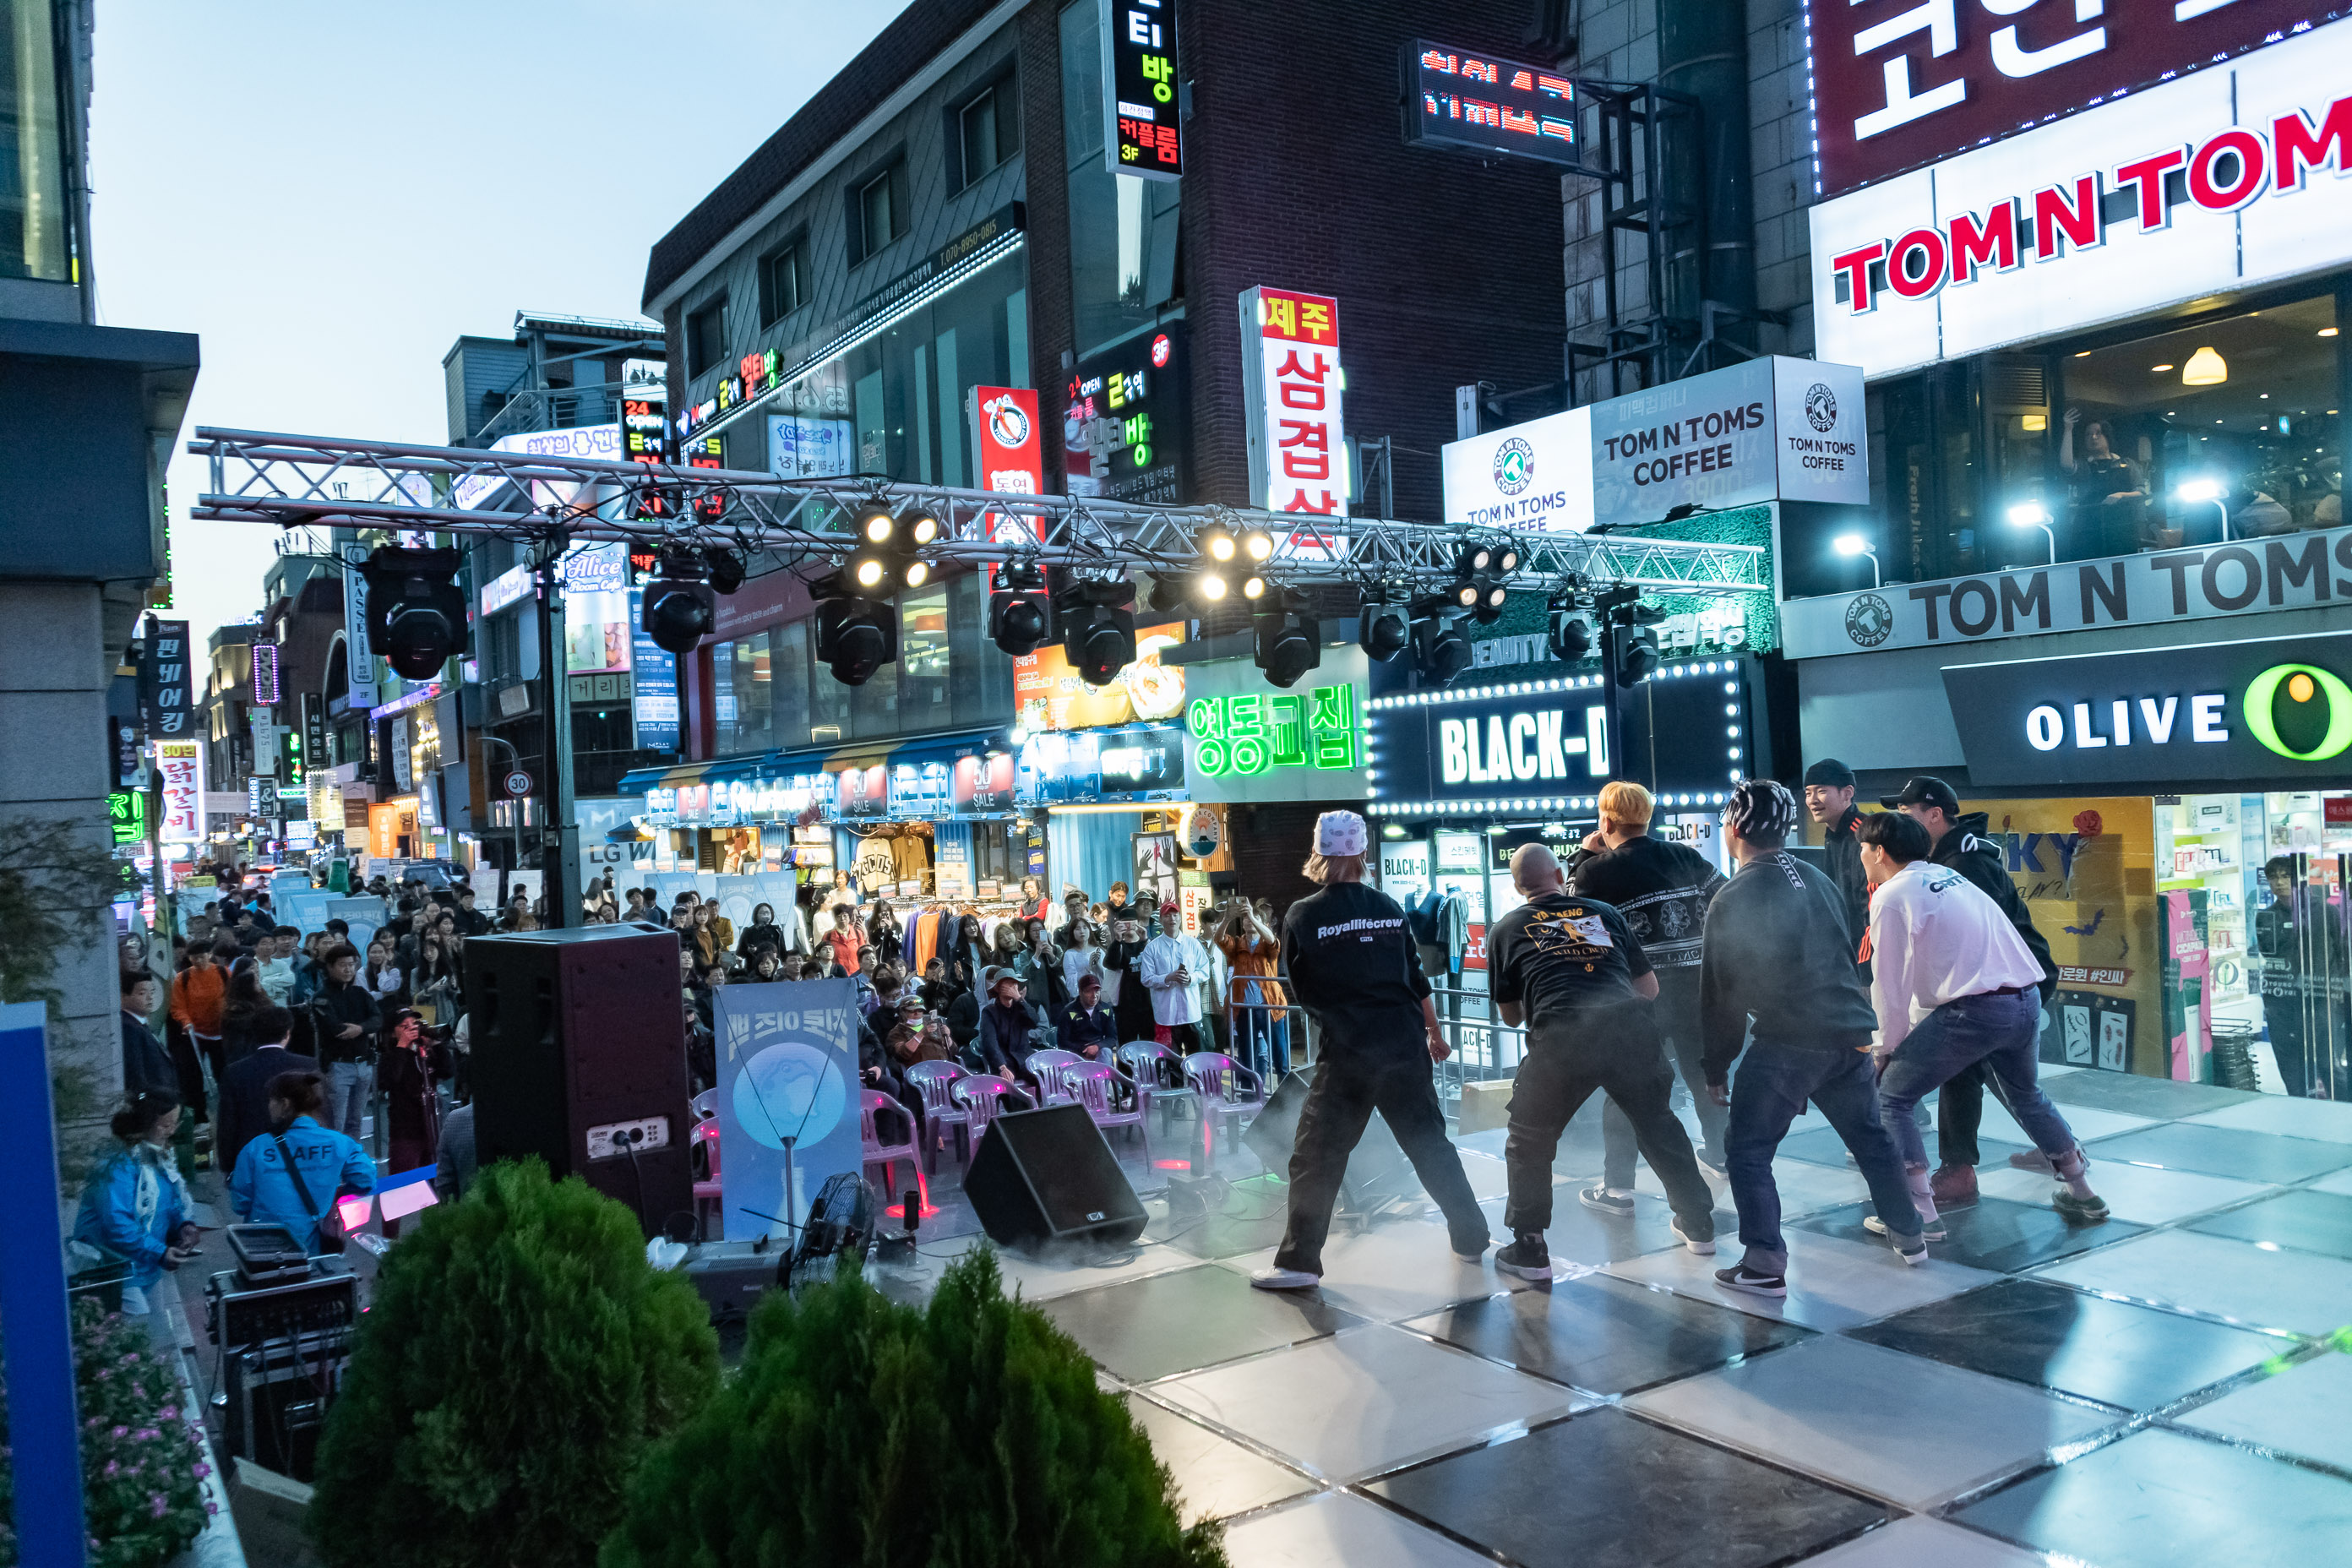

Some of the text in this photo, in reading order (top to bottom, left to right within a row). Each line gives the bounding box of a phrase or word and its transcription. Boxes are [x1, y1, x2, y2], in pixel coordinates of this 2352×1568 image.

[1120, 119, 1178, 164] 커플룸
[1121, 144, 1139, 161] 3F
[1830, 195, 2023, 315] TOM
[2031, 170, 2105, 264] N
[1267, 297, 1330, 340] 제주
[1153, 339, 1168, 362] 3F
[1069, 374, 1101, 399] 24 OPEN
[626, 400, 649, 416] 24
[1085, 396, 1094, 417] 룸
[1603, 402, 1765, 461] TOM N TOMS
[1808, 412, 1835, 432] COFFEE
[1081, 411, 1152, 479] 멀티방
[1494, 446, 1506, 473] TOM
[1513, 438, 1534, 466] TOMS
[1788, 437, 1856, 455] TOM N TOMS
[1634, 443, 1733, 486] COFFEE
[1802, 455, 1844, 471] COFFEE
[1496, 471, 1533, 495] COFFEE
[1467, 491, 1566, 525] TOM N TOMS
[567, 553, 623, 579] Alice
[630, 554, 656, 571] 커플
[569, 581, 599, 593] Room
[1847, 596, 1891, 623] TOM N TOMS
[1909, 571, 2051, 640] TOM
[2079, 562, 2129, 625] N
[1850, 625, 1890, 645] COFFEE
[156, 639, 184, 733] 펀비어킹
[360, 691, 370, 700] 2F
[1189, 683, 1355, 777] 영동교집
[2027, 693, 2230, 752] OLIVE
[162, 744, 197, 758] 30년
[1440, 706, 1609, 784] BLACK-D
[511, 777, 526, 790] 30
[973, 760, 993, 786] 50
[163, 760, 197, 832] 닭갈비
[852, 800, 870, 813] SALE
[973, 792, 994, 808] SALE
[1203, 810, 1218, 841] COMPANY
[590, 843, 621, 863] LG
[1385, 858, 1427, 876] BLACK-D
[2090, 968, 2125, 984] #인싸
[263, 1145, 333, 1163] SAFF
